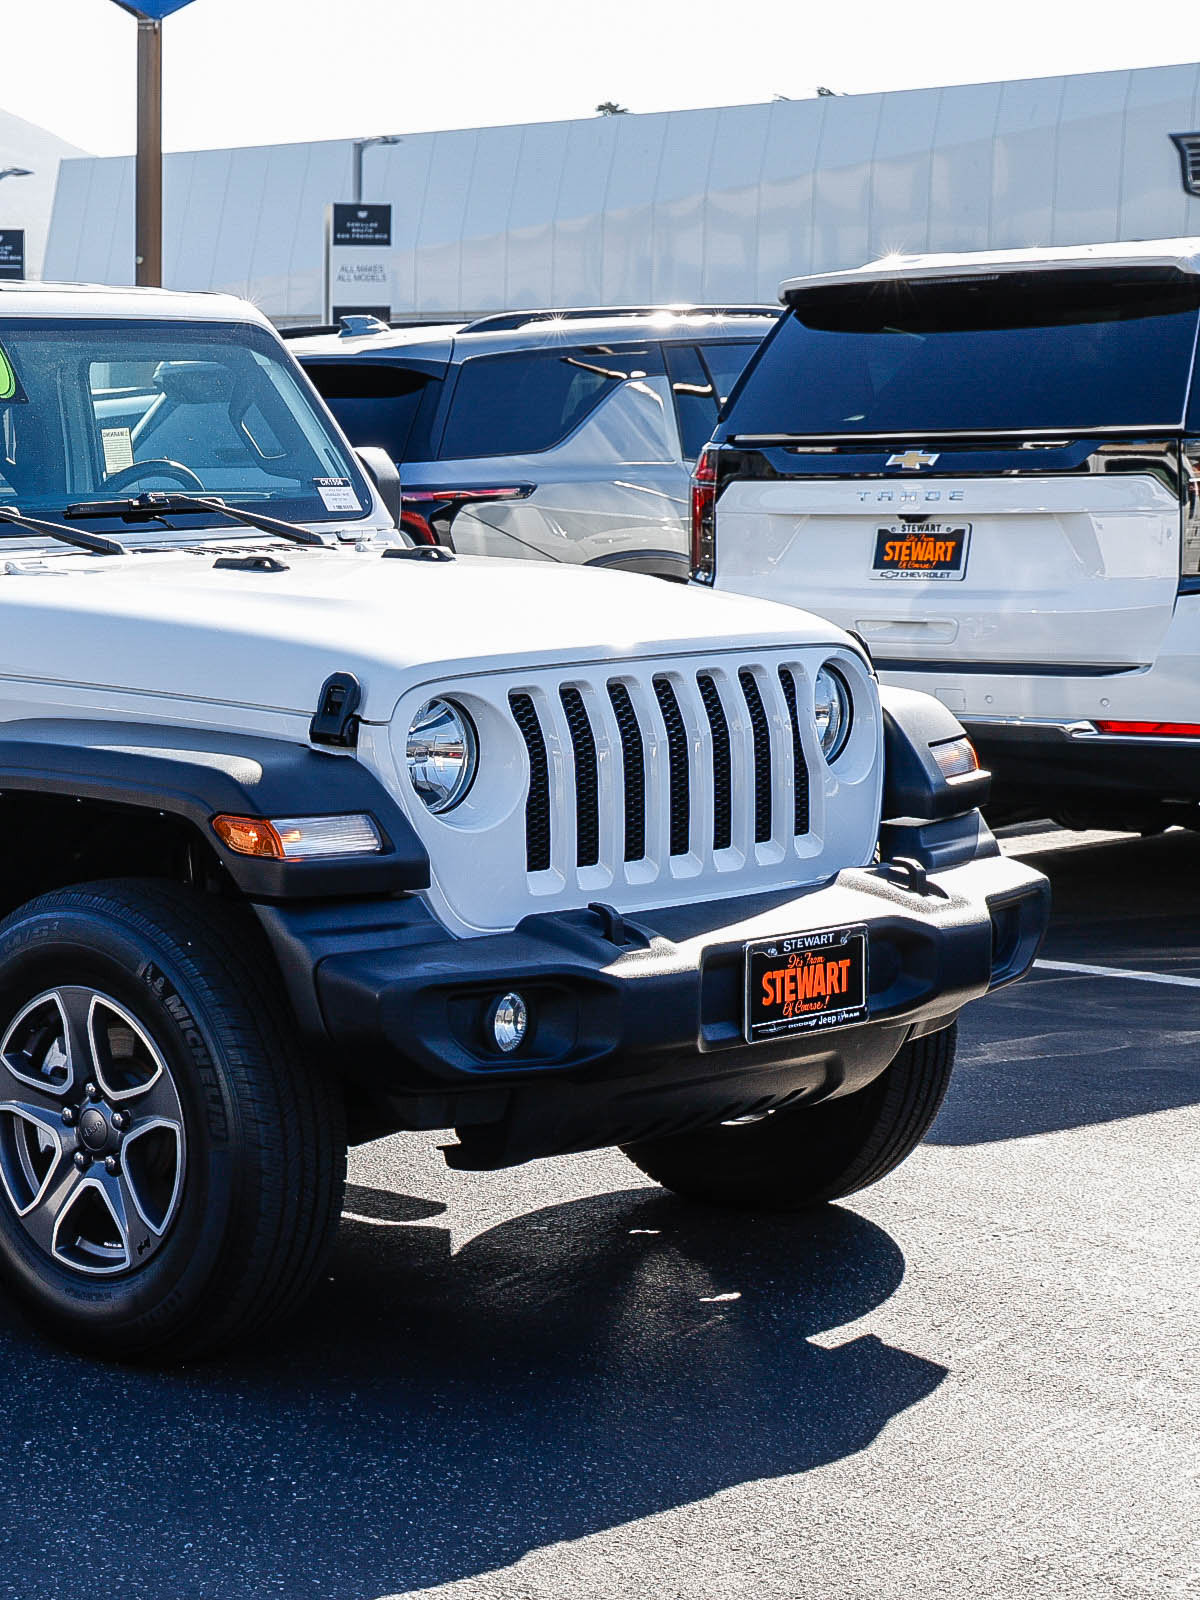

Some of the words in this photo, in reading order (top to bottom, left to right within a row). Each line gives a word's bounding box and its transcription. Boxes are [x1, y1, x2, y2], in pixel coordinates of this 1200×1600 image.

[856, 490, 965, 502] TAHOE
[901, 524, 942, 533] STEWART
[883, 541, 957, 561] STEWART
[900, 571, 952, 579] CHEVROLET
[783, 933, 835, 952] STEWART
[804, 952, 825, 966] From
[761, 959, 851, 1007] STEWART
[782, 1000, 794, 1018] Of
[795, 995, 830, 1014] Course!
[818, 1015, 837, 1026] Jeep
[163, 993, 228, 1142] MICHELIN
